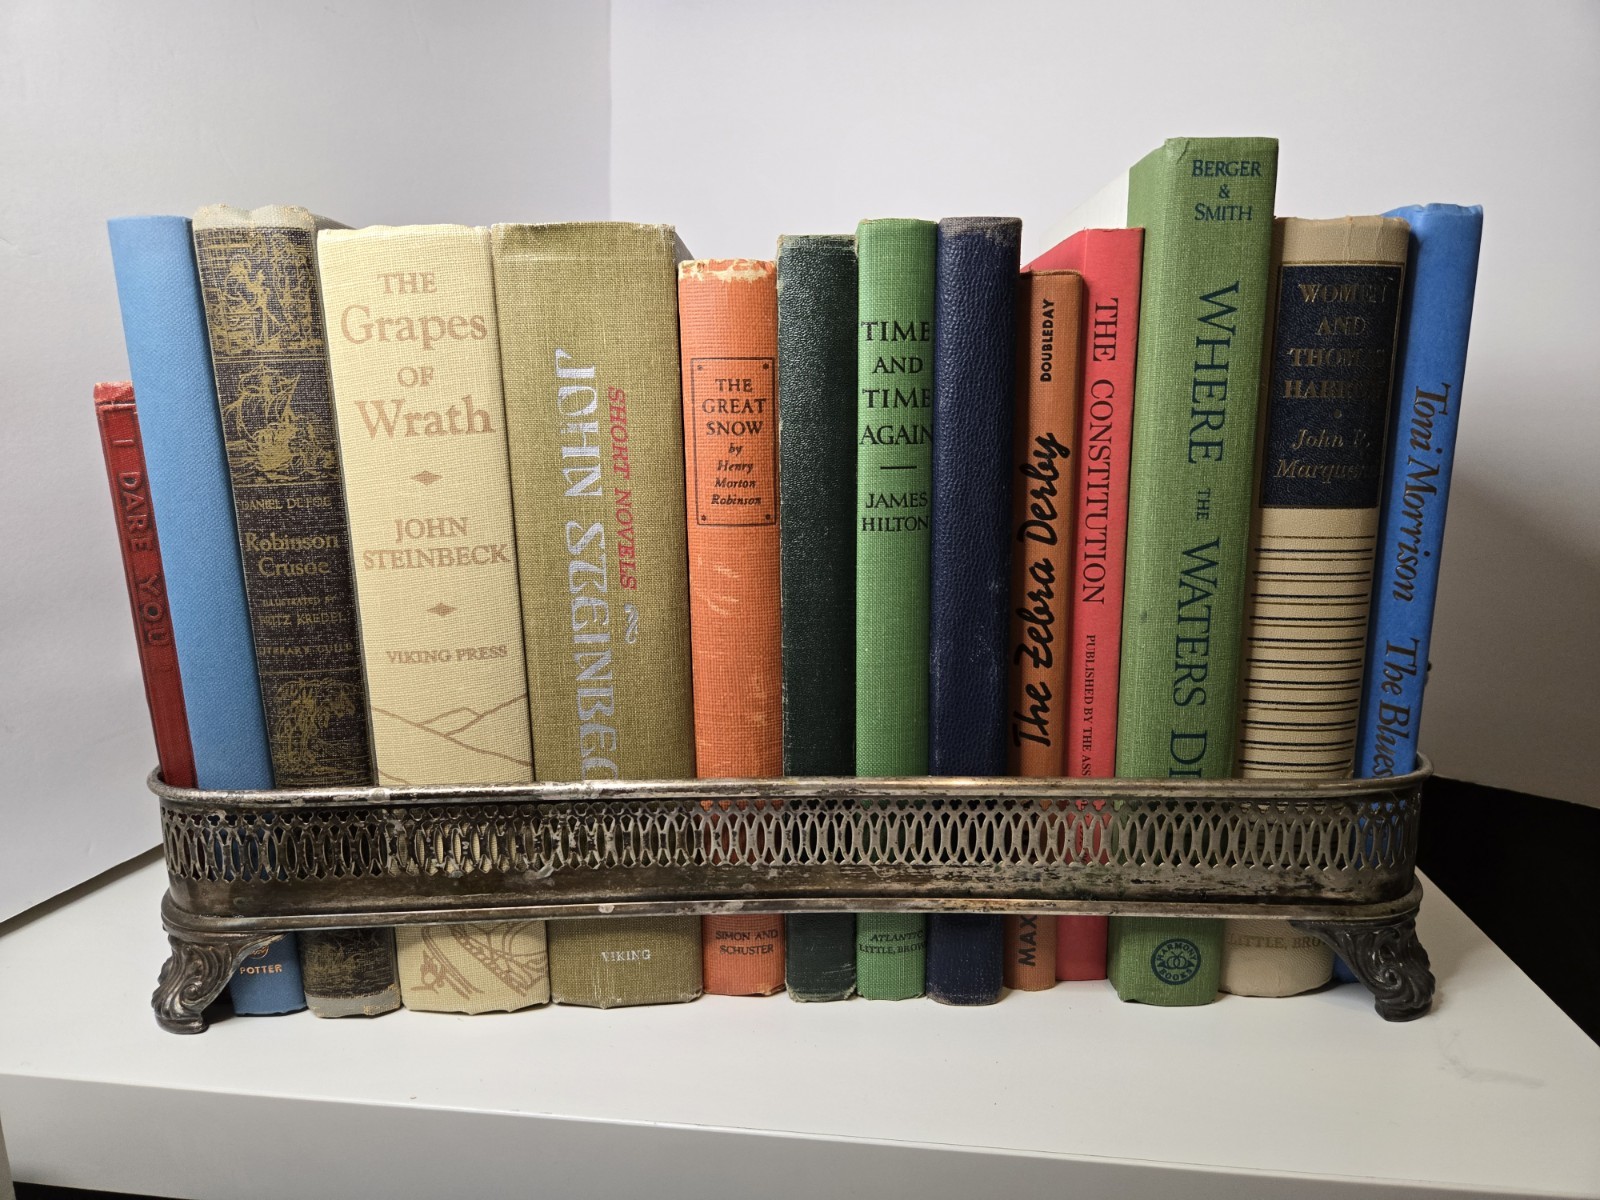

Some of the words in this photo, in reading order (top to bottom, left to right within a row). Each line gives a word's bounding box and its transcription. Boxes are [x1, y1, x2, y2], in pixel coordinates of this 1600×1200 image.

[1191, 159, 1262, 177] BERGER
[1218, 184, 1231, 199] &
[1194, 202, 1253, 221] SMITH
[376, 271, 438, 295] THE
[340, 304, 488, 351] Grapes
[861, 320, 931, 342] TIME
[1092, 297, 1119, 362] THE
[1314, 316, 1366, 336] AND
[1040, 298, 1055, 382] DOUBLEDAY
[872, 356, 924, 375] AND
[1188, 280, 1240, 464] WHERE
[396, 365, 435, 388] OF
[714, 378, 753, 393] THE
[701, 398, 767, 414] GREAT
[861, 387, 931, 410] TIME
[353, 393, 497, 440] Wrath
[554, 348, 604, 498] JOHN
[1409, 382, 1452, 454] Toni
[608, 386, 632, 481] SHORT
[705, 420, 765, 436] SNOW
[859, 424, 934, 446] AGAIN
[1291, 428, 1344, 449] John
[727, 442, 744, 457] by
[716, 459, 754, 474] Henry
[714, 477, 757, 489] Morton
[1016, 432, 1071, 546] Derby
[1082, 379, 1115, 605] CONSTITUTION
[241, 498, 284, 510] DANIEL
[711, 494, 762, 505] Robinson
[865, 492, 928, 508] JAMES
[1196, 488, 1211, 521] THE
[394, 516, 470, 544] JOHN
[861, 515, 930, 532] HILTON
[1391, 455, 1442, 602] Morrison
[244, 531, 341, 551] Robinson
[614, 487, 638, 590] NOVELS
[117, 471, 155, 552] DARE
[138, 573, 172, 647] YOU
[258, 556, 332, 577] Crusoe
[362, 542, 512, 572] STEINBECK
[1013, 557, 1056, 669] Zebra
[1172, 536, 1221, 707] WATERS
[385, 649, 452, 665] VIKING
[455, 644, 509, 661] PRESS
[1084, 635, 1096, 704] PUBLISHED
[1380, 636, 1420, 696] The
[1012, 681, 1053, 748] The
[1083, 707, 1094, 724] BY
[1082, 728, 1093, 751] THE
[715, 930, 751, 941] SIMON
[755, 928, 778, 940] AND
[869, 930, 924, 942] ATLANTIC
[1018, 914, 1037, 967] MAX
[1291, 936, 1327, 949] BRO
[601, 949, 651, 961] VIKING
[719, 943, 774, 955] SCHUSTER
[1156, 942, 1197, 960] HARMONY
[239, 963, 283, 976] POTTER
[1159, 968, 1193, 981] BOOKS
